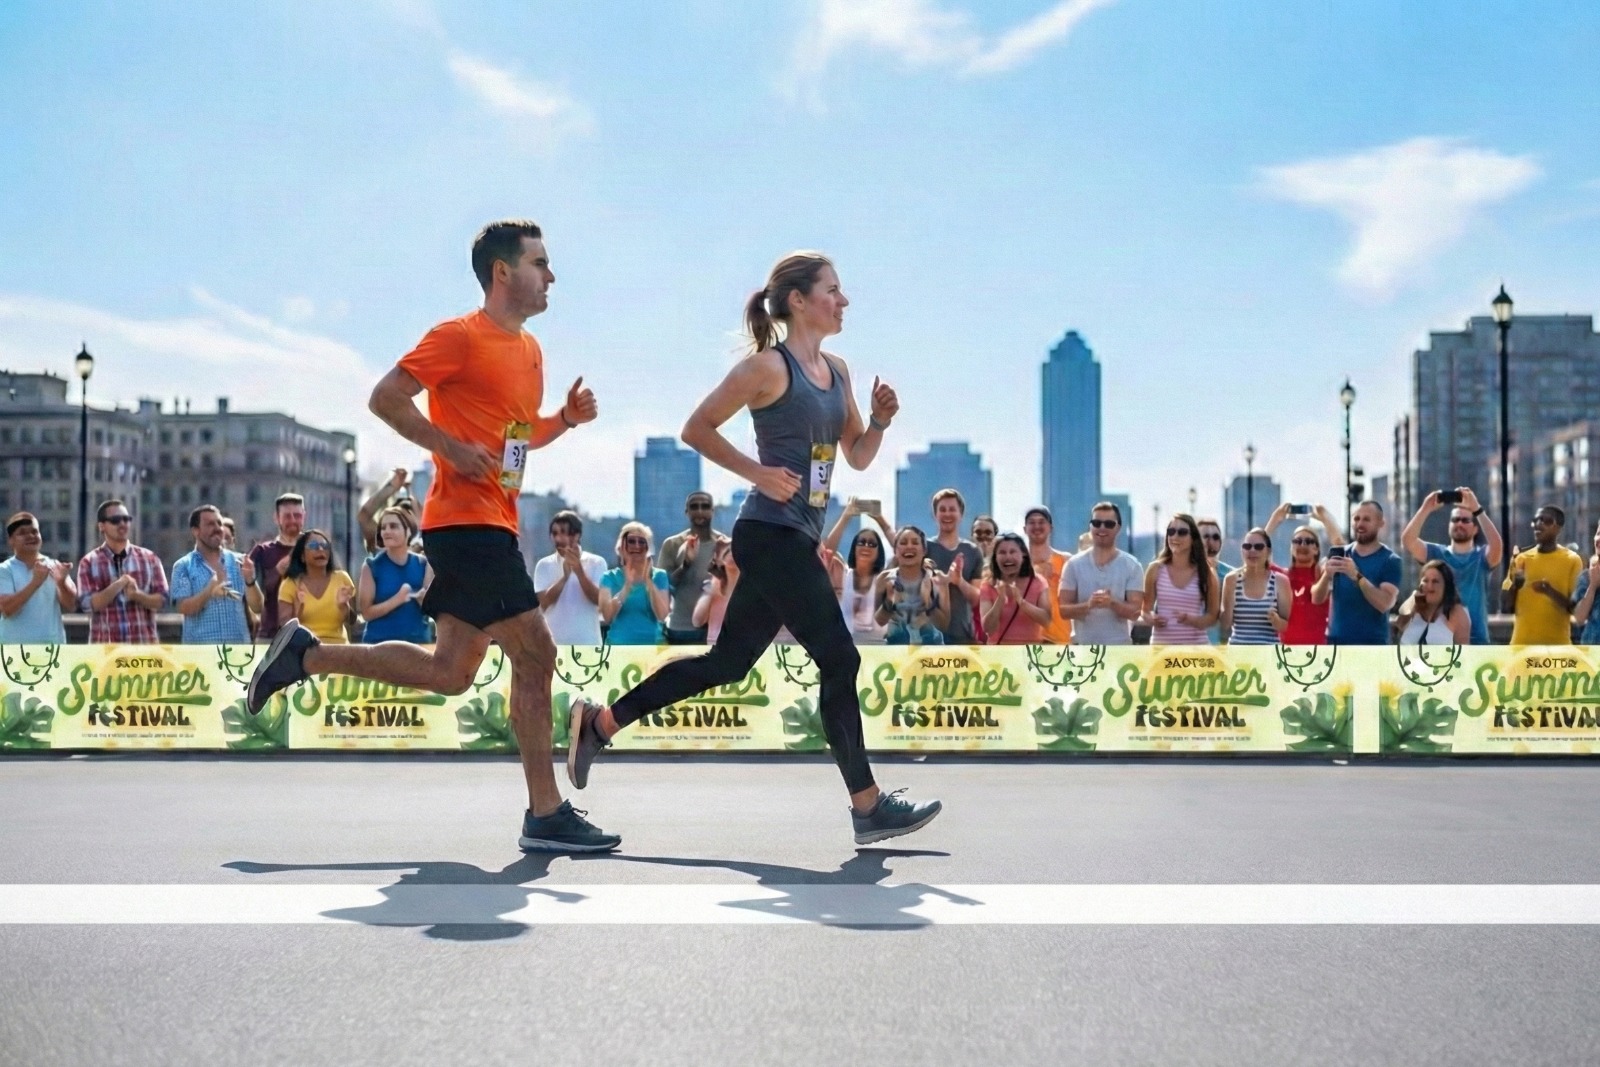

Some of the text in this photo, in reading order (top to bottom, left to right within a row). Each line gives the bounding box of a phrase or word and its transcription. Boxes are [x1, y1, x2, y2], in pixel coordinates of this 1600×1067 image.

[57, 663, 213, 716] Summer
[859, 662, 1021, 717] Summer
[1102, 662, 1268, 718] Summer
[88, 702, 191, 727] FESTIVAL
[324, 704, 425, 727] FESTIVAL
[1135, 704, 1246, 728] FESTIVAL
